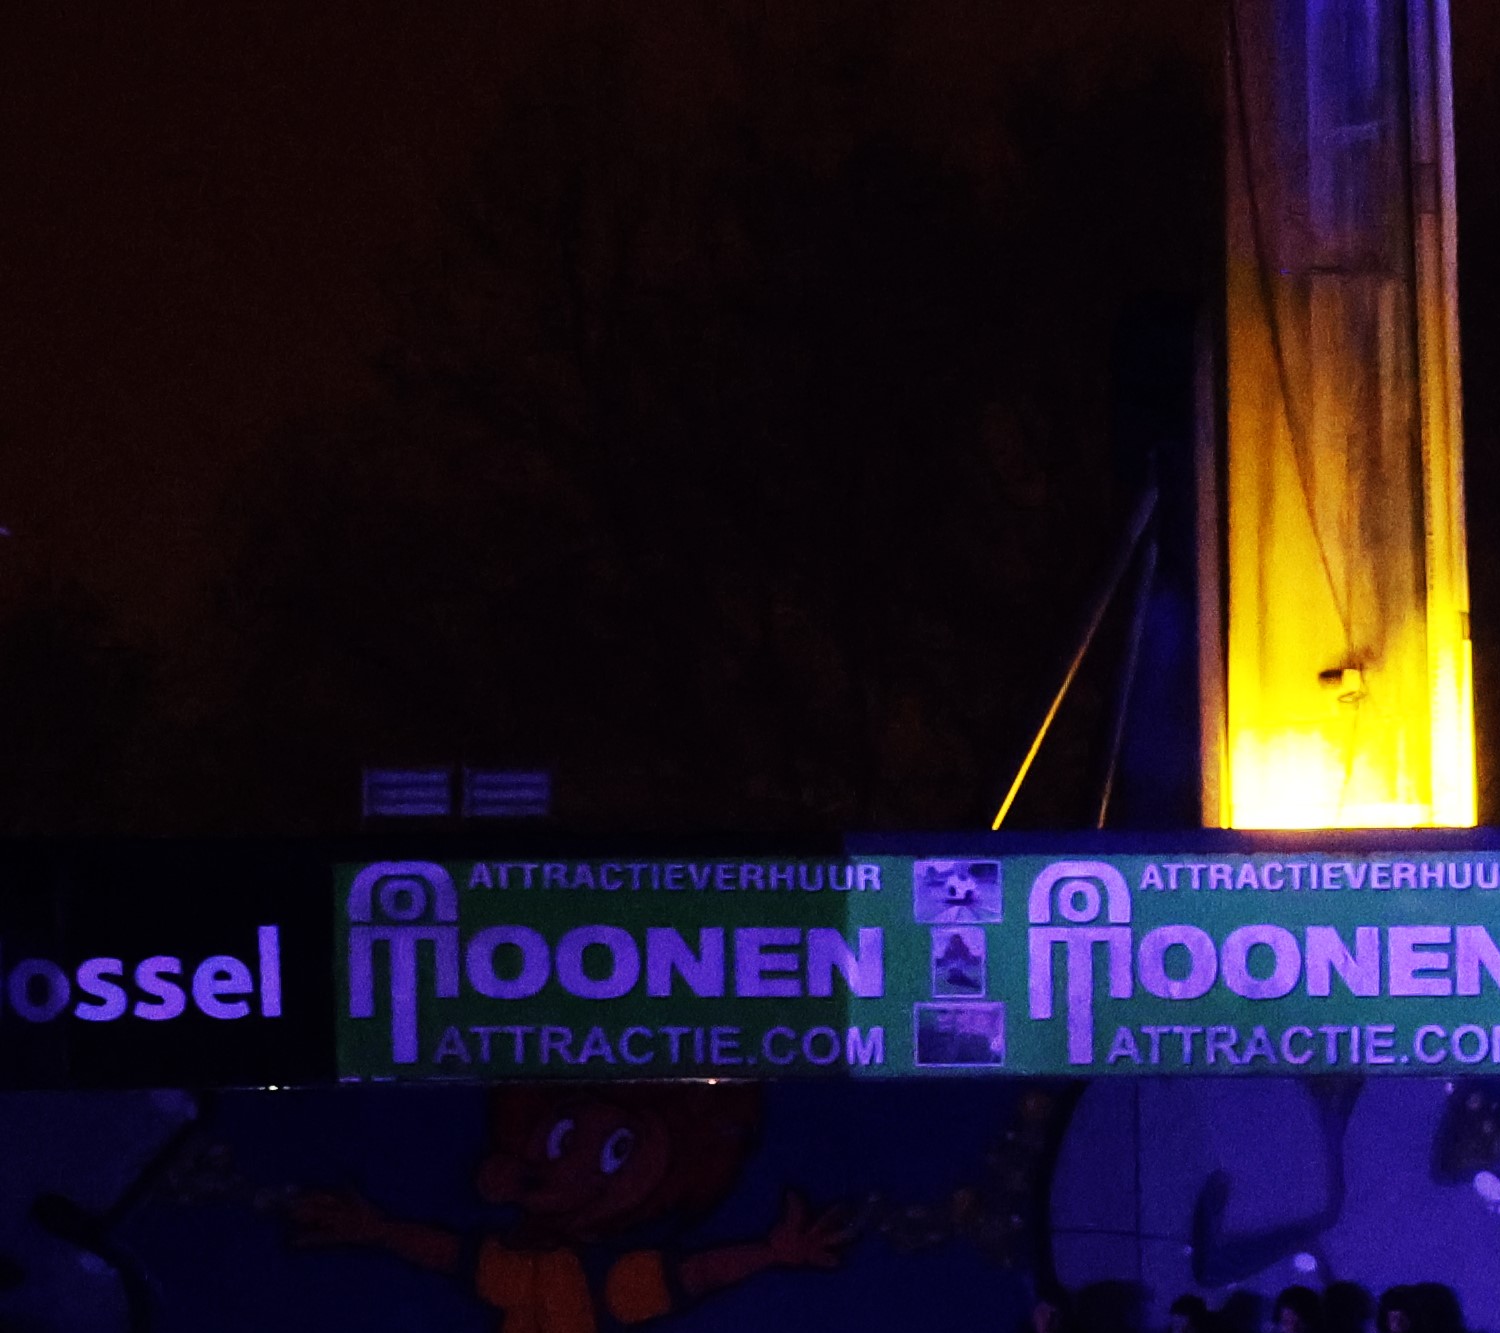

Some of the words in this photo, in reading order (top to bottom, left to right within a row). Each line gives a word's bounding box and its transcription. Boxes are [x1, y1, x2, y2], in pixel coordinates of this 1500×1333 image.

[468, 863, 882, 892] ATTRACTIEVERHUUR
[7, 925, 281, 1022] ossel
[433, 1026, 884, 1065] ATTRACTIE.COM
